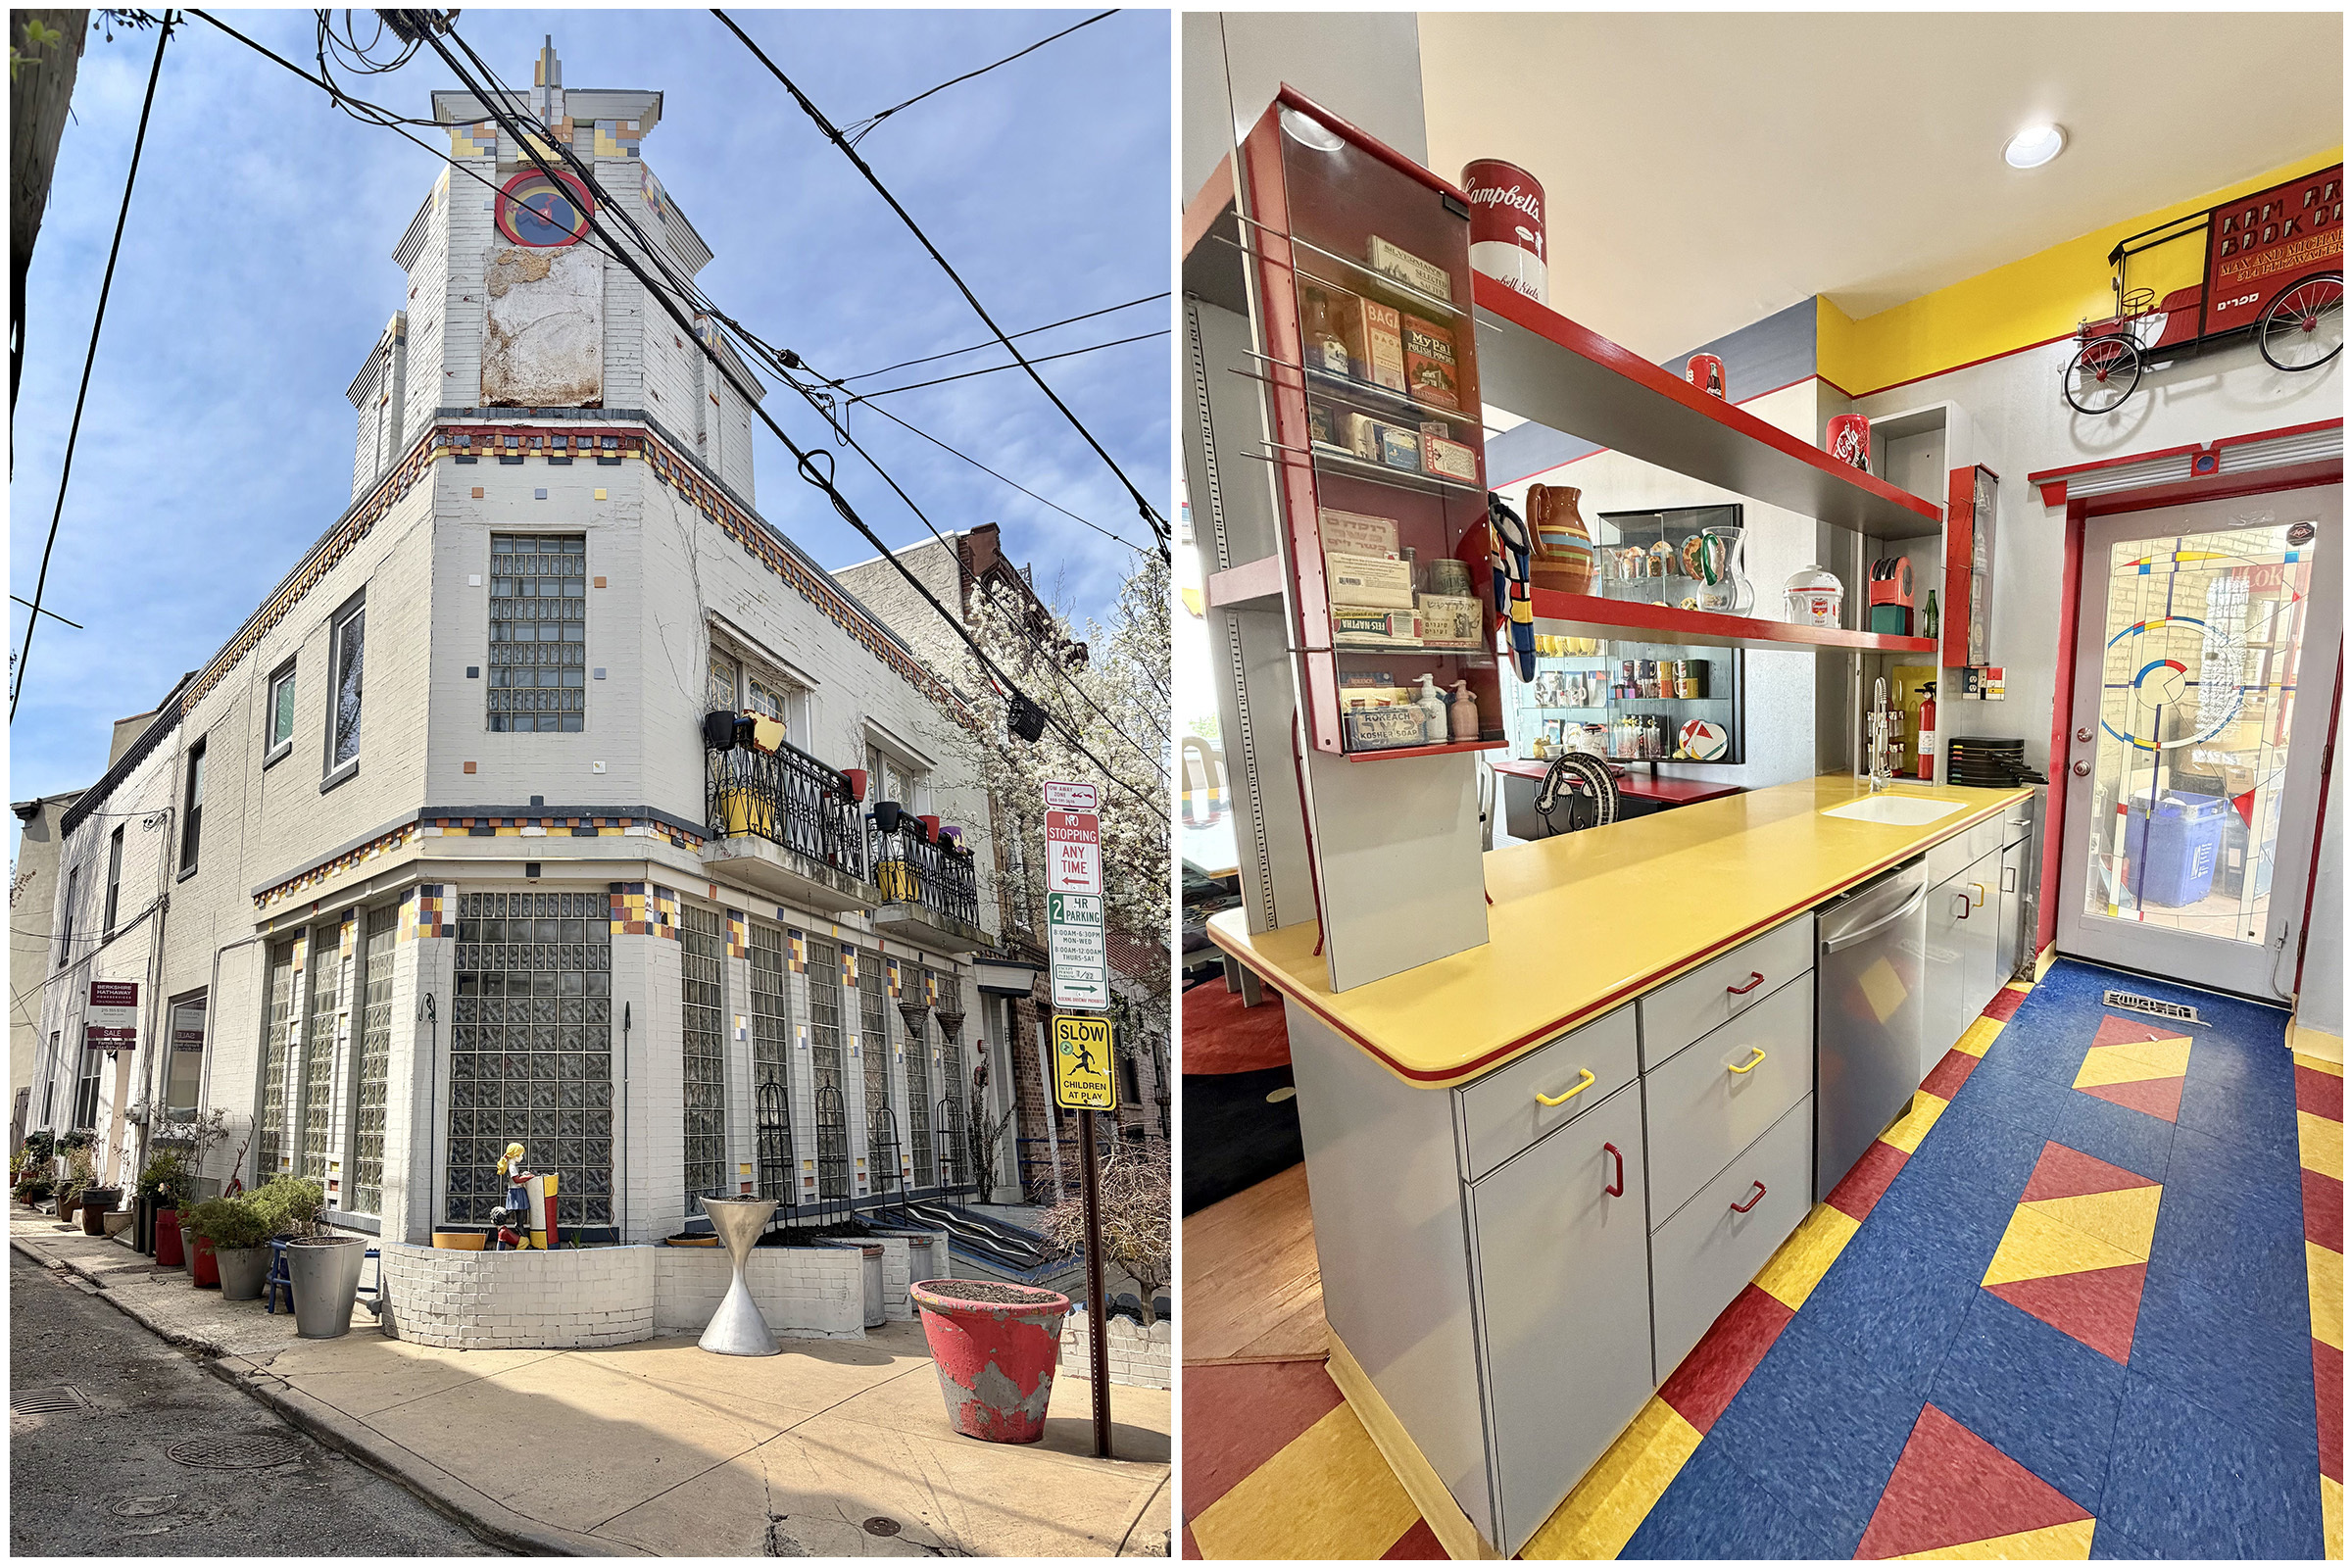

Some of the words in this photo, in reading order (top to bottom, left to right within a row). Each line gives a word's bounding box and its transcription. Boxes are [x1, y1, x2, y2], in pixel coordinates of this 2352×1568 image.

[2223, 199, 2283, 235] KAM
[2221, 214, 2303, 257] BOOK
[2221, 256, 2252, 276] MAX
[2253, 246, 2282, 269] AND
[2217, 292, 2259, 311] ספרים
[1407, 342, 1431, 357] POLISH
[1365, 712, 1410, 722] ROKEACH
[1360, 731, 1394, 740] KOSHER
[1396, 728, 1418, 738] SOAP
[1064, 814, 1079, 827] NO
[1049, 827, 1097, 843] STOPPING
[1061, 845, 1085, 859] ANY
[1061, 859, 1088, 874] TIME
[1053, 899, 1062, 920] 2
[1074, 898, 1089, 909] HR
[1066, 910, 1100, 923] PARKING
[1059, 1024, 1104, 1042] SLOW
[1063, 1081, 1106, 1091] CHILDREN
